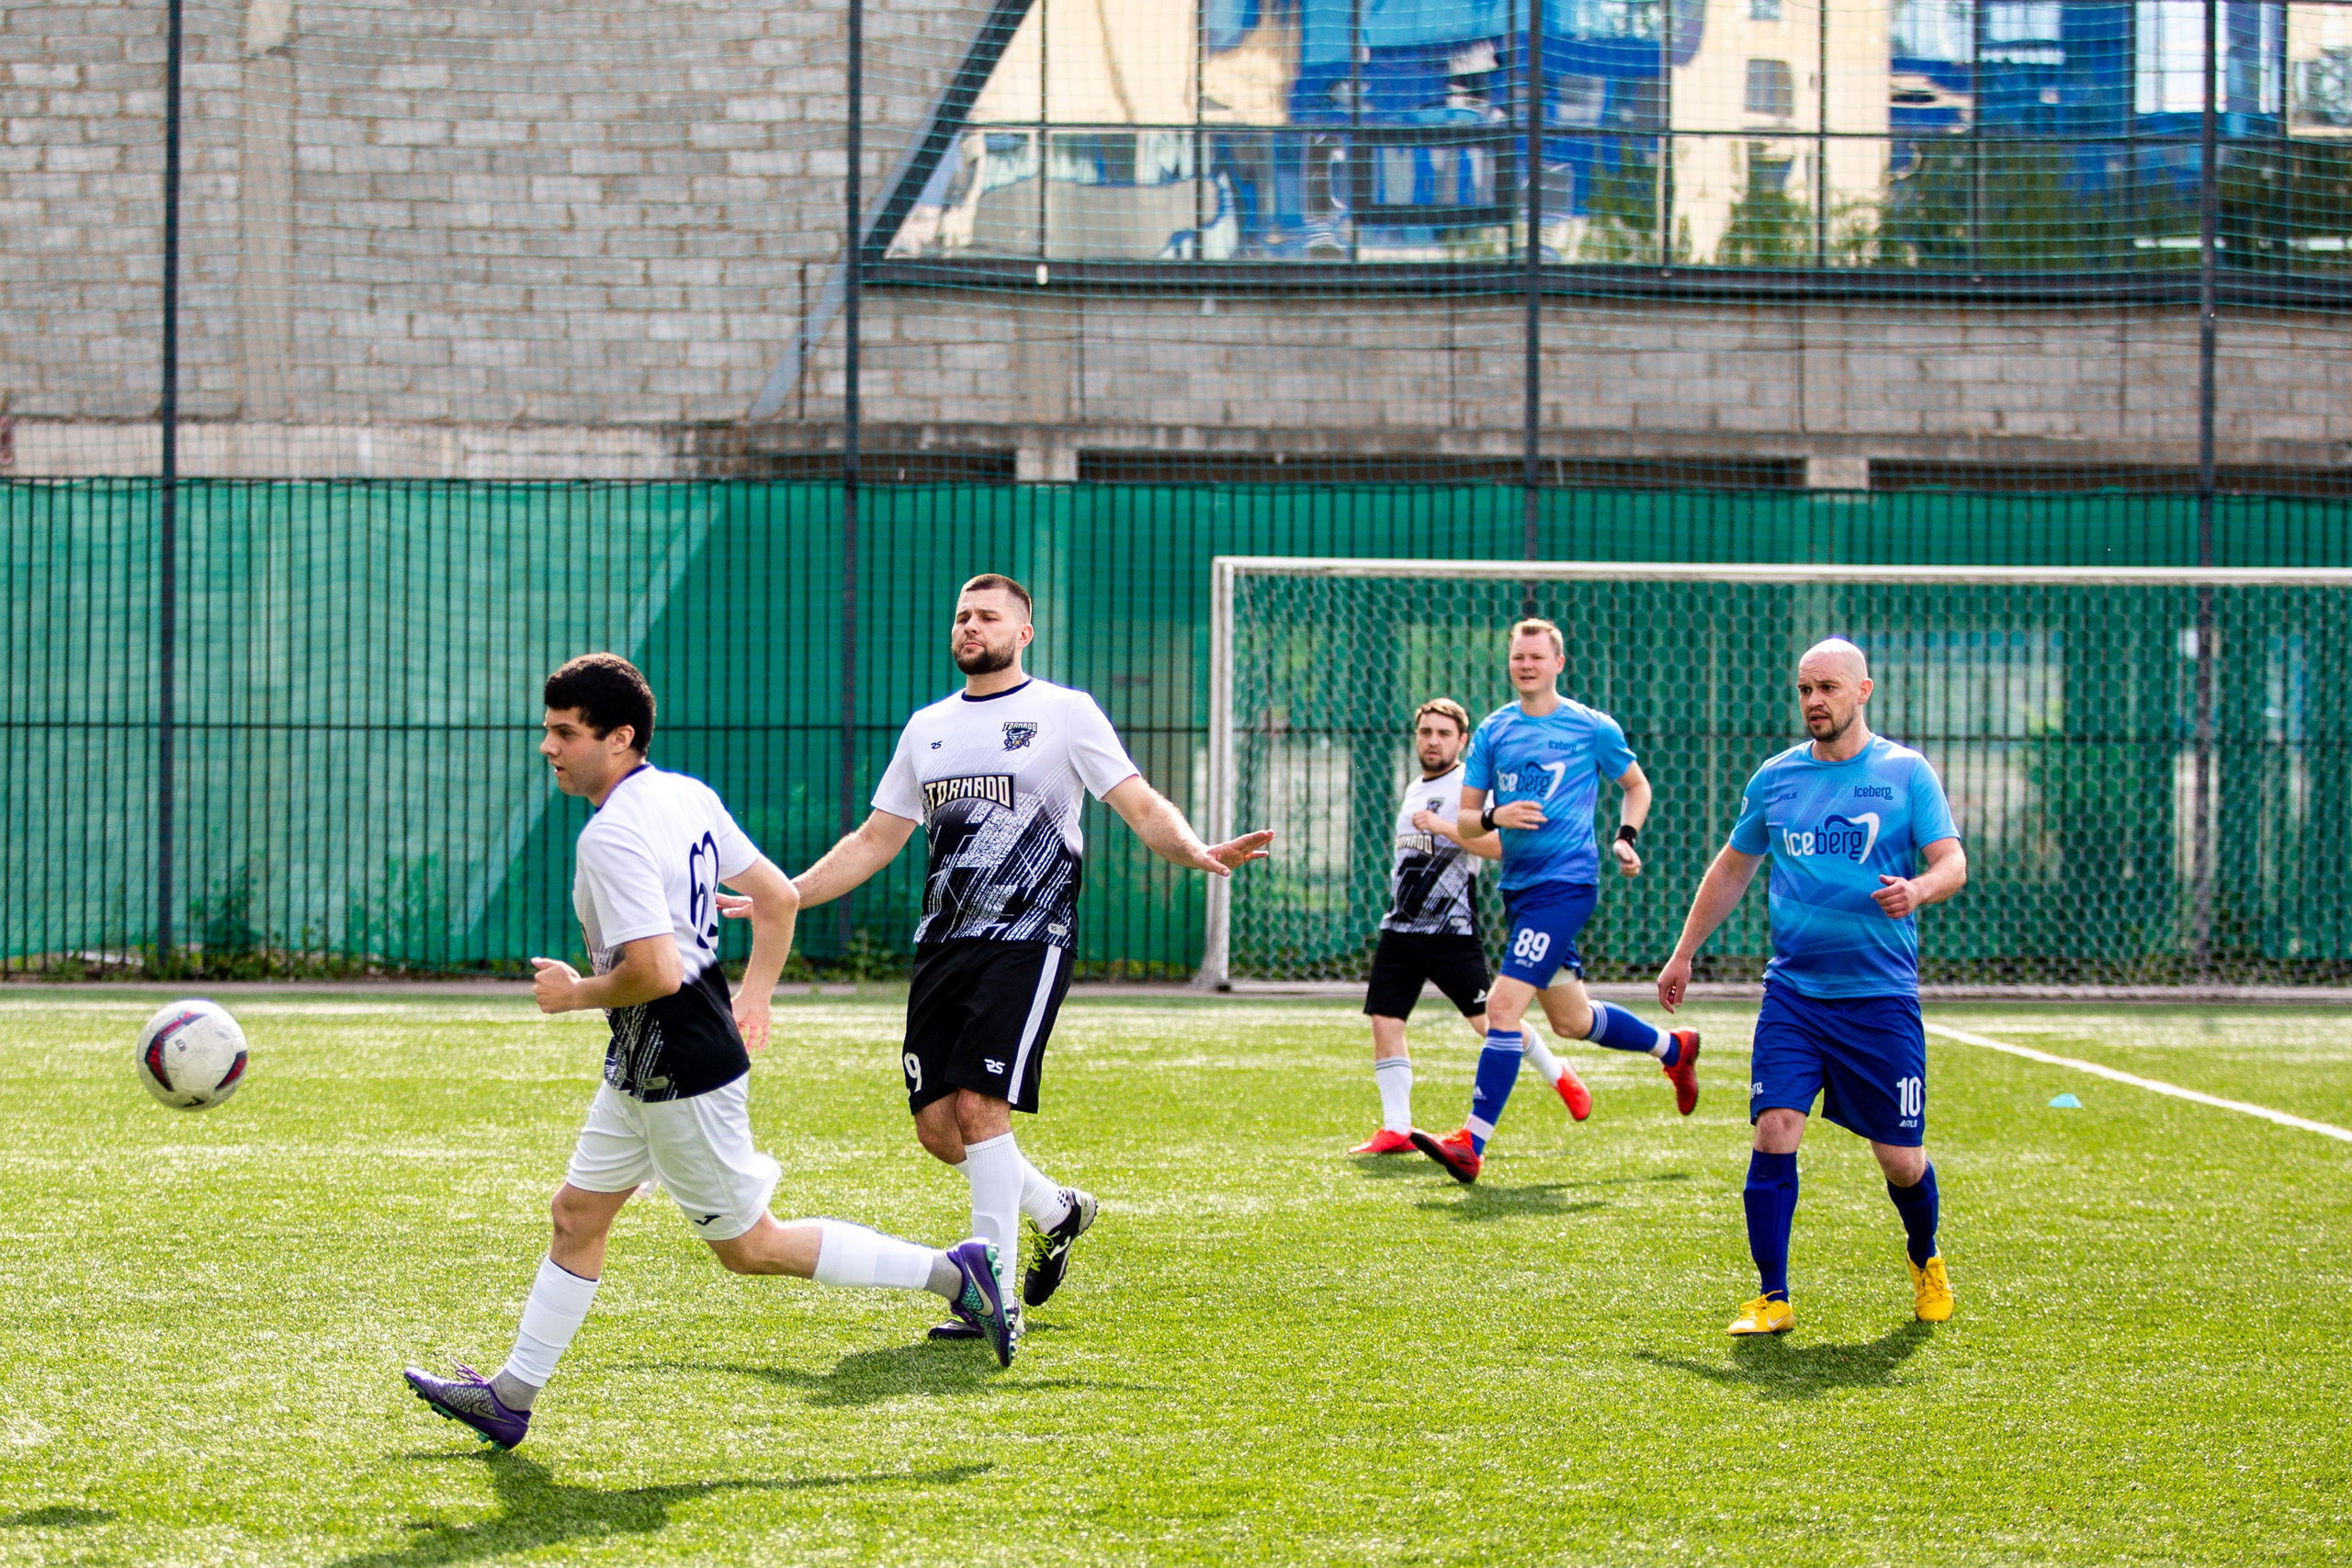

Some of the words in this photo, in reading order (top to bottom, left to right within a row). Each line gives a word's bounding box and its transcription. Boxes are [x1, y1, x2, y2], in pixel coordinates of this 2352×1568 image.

[1547, 739, 1577, 754] Iceberg
[924, 775, 1012, 812] TORNADO
[1497, 769, 1551, 797] Iceberg
[1854, 784, 1894, 801] Iceberg
[1782, 825, 1863, 862] Iceberg
[1513, 928, 1551, 963] 89
[903, 1052, 922, 1093] 9
[1896, 1076, 1922, 1117] 10
